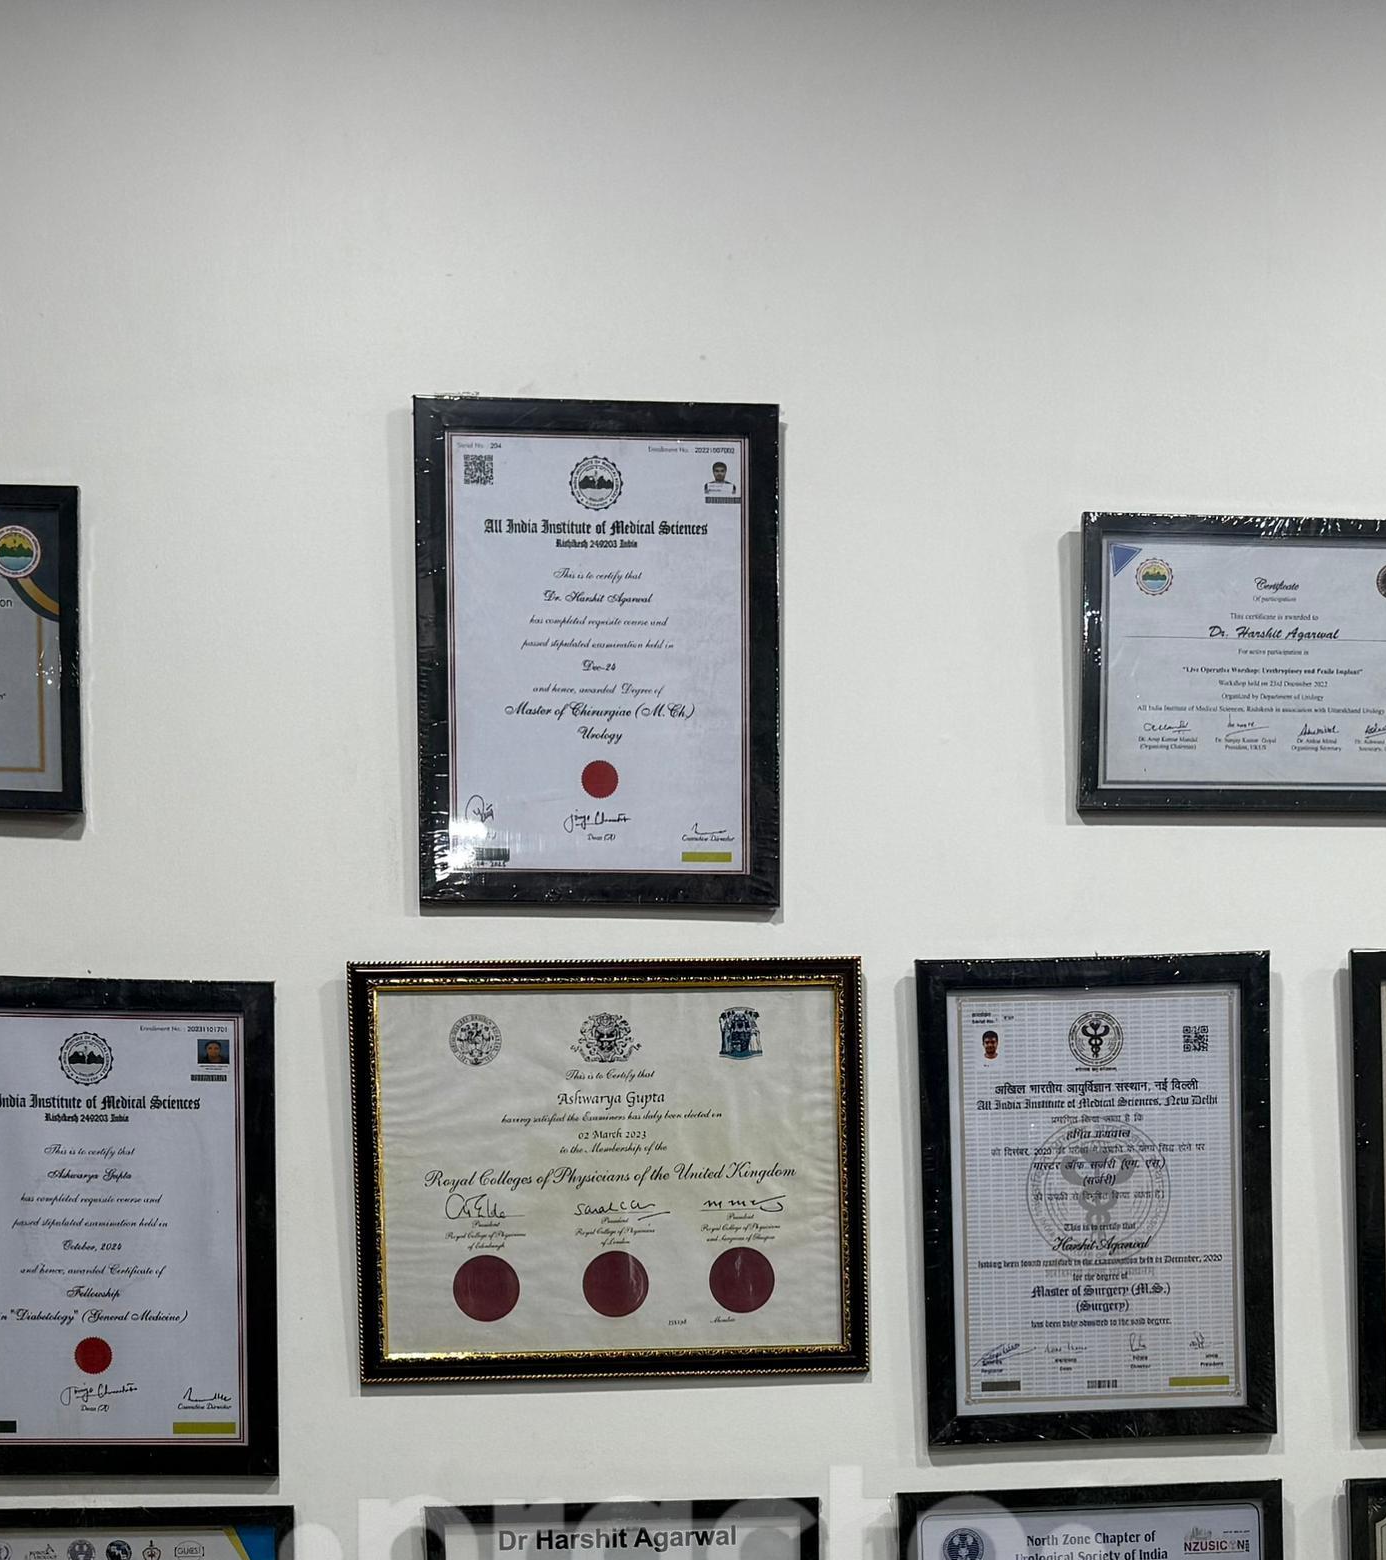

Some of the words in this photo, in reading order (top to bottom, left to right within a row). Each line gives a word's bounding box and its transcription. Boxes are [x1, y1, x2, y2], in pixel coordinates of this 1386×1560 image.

[484, 518, 502, 533] All
[506, 519, 538, 534] India
[541, 519, 592, 534] Institute
[595, 520, 606, 535] of
[610, 520, 655, 536] Medical
[658, 520, 708, 535] Sciences
[565, 591, 605, 603] Harshit
[607, 592, 653, 607] Agarwal
[1235, 626, 1282, 639] Harshit
[1284, 627, 1340, 642] Agarwal
[577, 726, 623, 745] Urology
[29, 1093, 82, 1109] Institute
[86, 1095, 97, 1109] of
[100, 1095, 146, 1110] Medical
[150, 1095, 200, 1110] Sciences
[557, 1089, 621, 1110] Ashwarya
[626, 1091, 664, 1110] Gupta
[578, 1132, 589, 1140] 02
[592, 1128, 622, 1139] March
[625, 1131, 647, 1140] 2023
[424, 1170, 477, 1191] Royal
[479, 1169, 532, 1190] Colleges
[536, 1168, 553, 1189] of
[552, 1167, 630, 1187] Physicians
[634, 1165, 649, 1186] of
[650, 1166, 670, 1181] the
[674, 1163, 724, 1180] United
[726, 1162, 796, 1182] Kingdom
[66, 1285, 120, 1301] Fellowship
[1030, 1285, 1069, 1298] Master
[1071, 1285, 1081, 1296] of
[1083, 1284, 1129, 1297] Surgery
[1131, 1282, 1171, 1296] (M.S.)
[1076, 1299, 1129, 1313] (Surgery)
[498, 1530, 530, 1551] Dr
[536, 1528, 630, 1550] Harshit
[633, 1525, 735, 1552] Agarwal
[1026, 1535, 1058, 1547] North
[1062, 1534, 1091, 1545] Zone
[1095, 1532, 1141, 1547] Chapter
[1144, 1530, 1156, 1542] of
[1124, 1549, 1136, 1560] of
[1139, 1547, 1168, 1560] India
